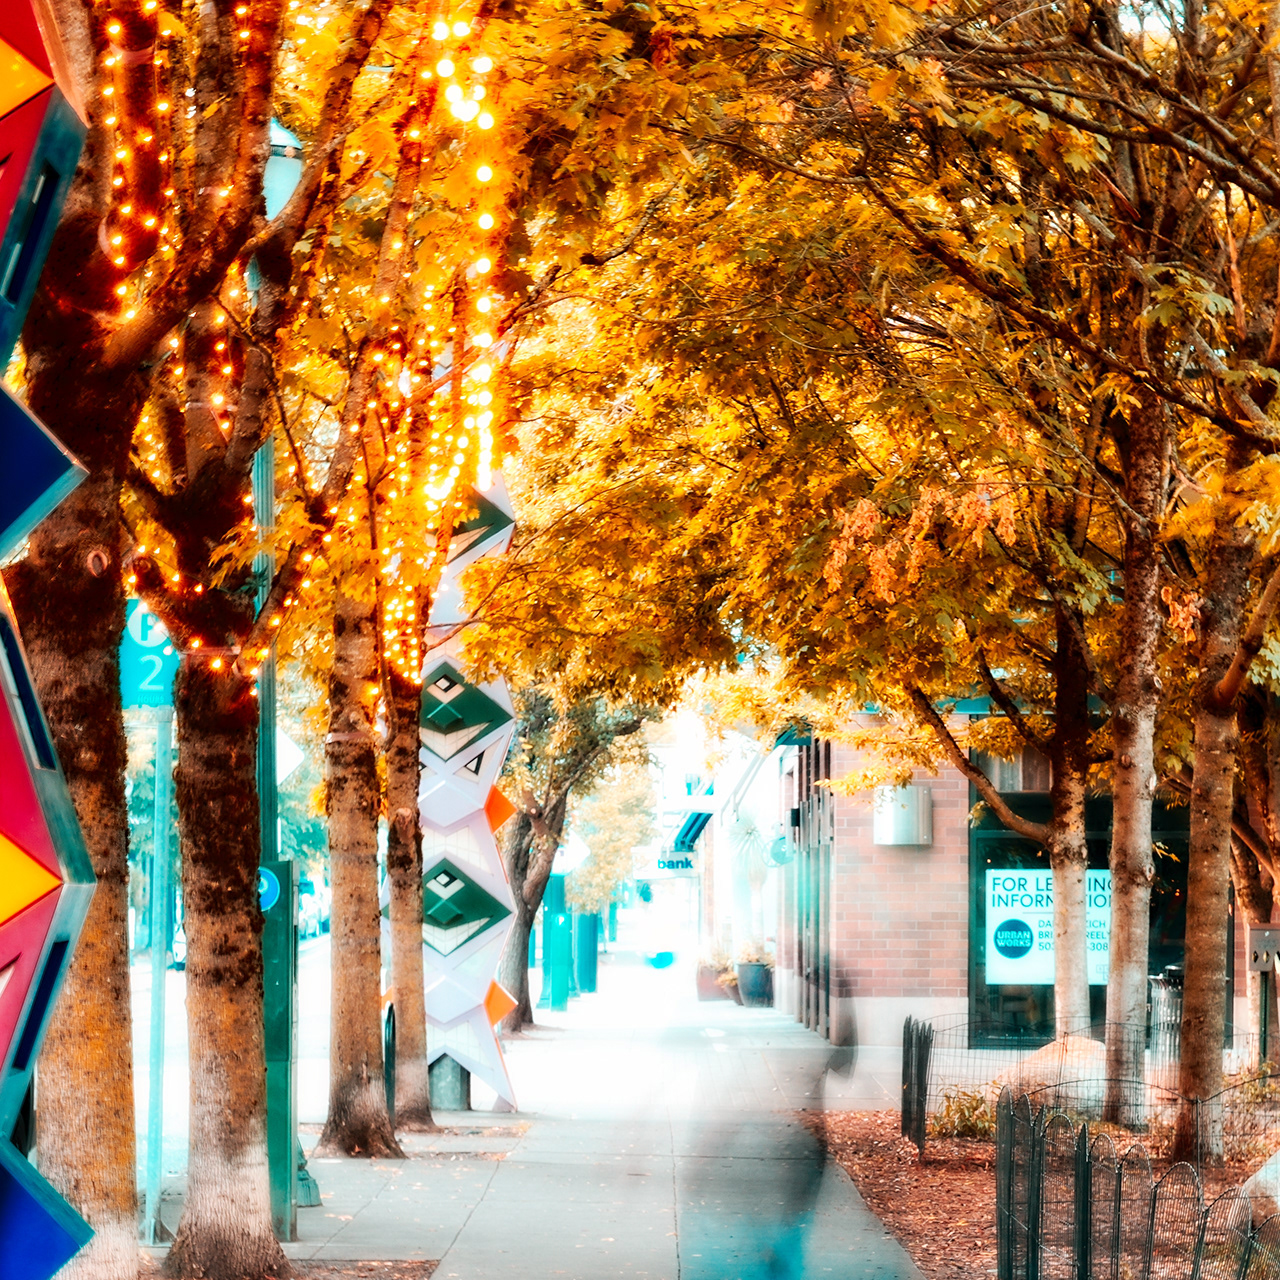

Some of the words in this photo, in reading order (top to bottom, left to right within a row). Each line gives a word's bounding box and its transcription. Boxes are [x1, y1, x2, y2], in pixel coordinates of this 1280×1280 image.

[139, 654, 164, 691] 2
[137, 695, 164, 704] HOURS
[657, 857, 694, 870] bank
[992, 877, 1028, 892] FOR
[1036, 877, 1112, 892] LEIN
[997, 931, 1031, 939] URBAN
[997, 939, 1031, 948] WORKS
